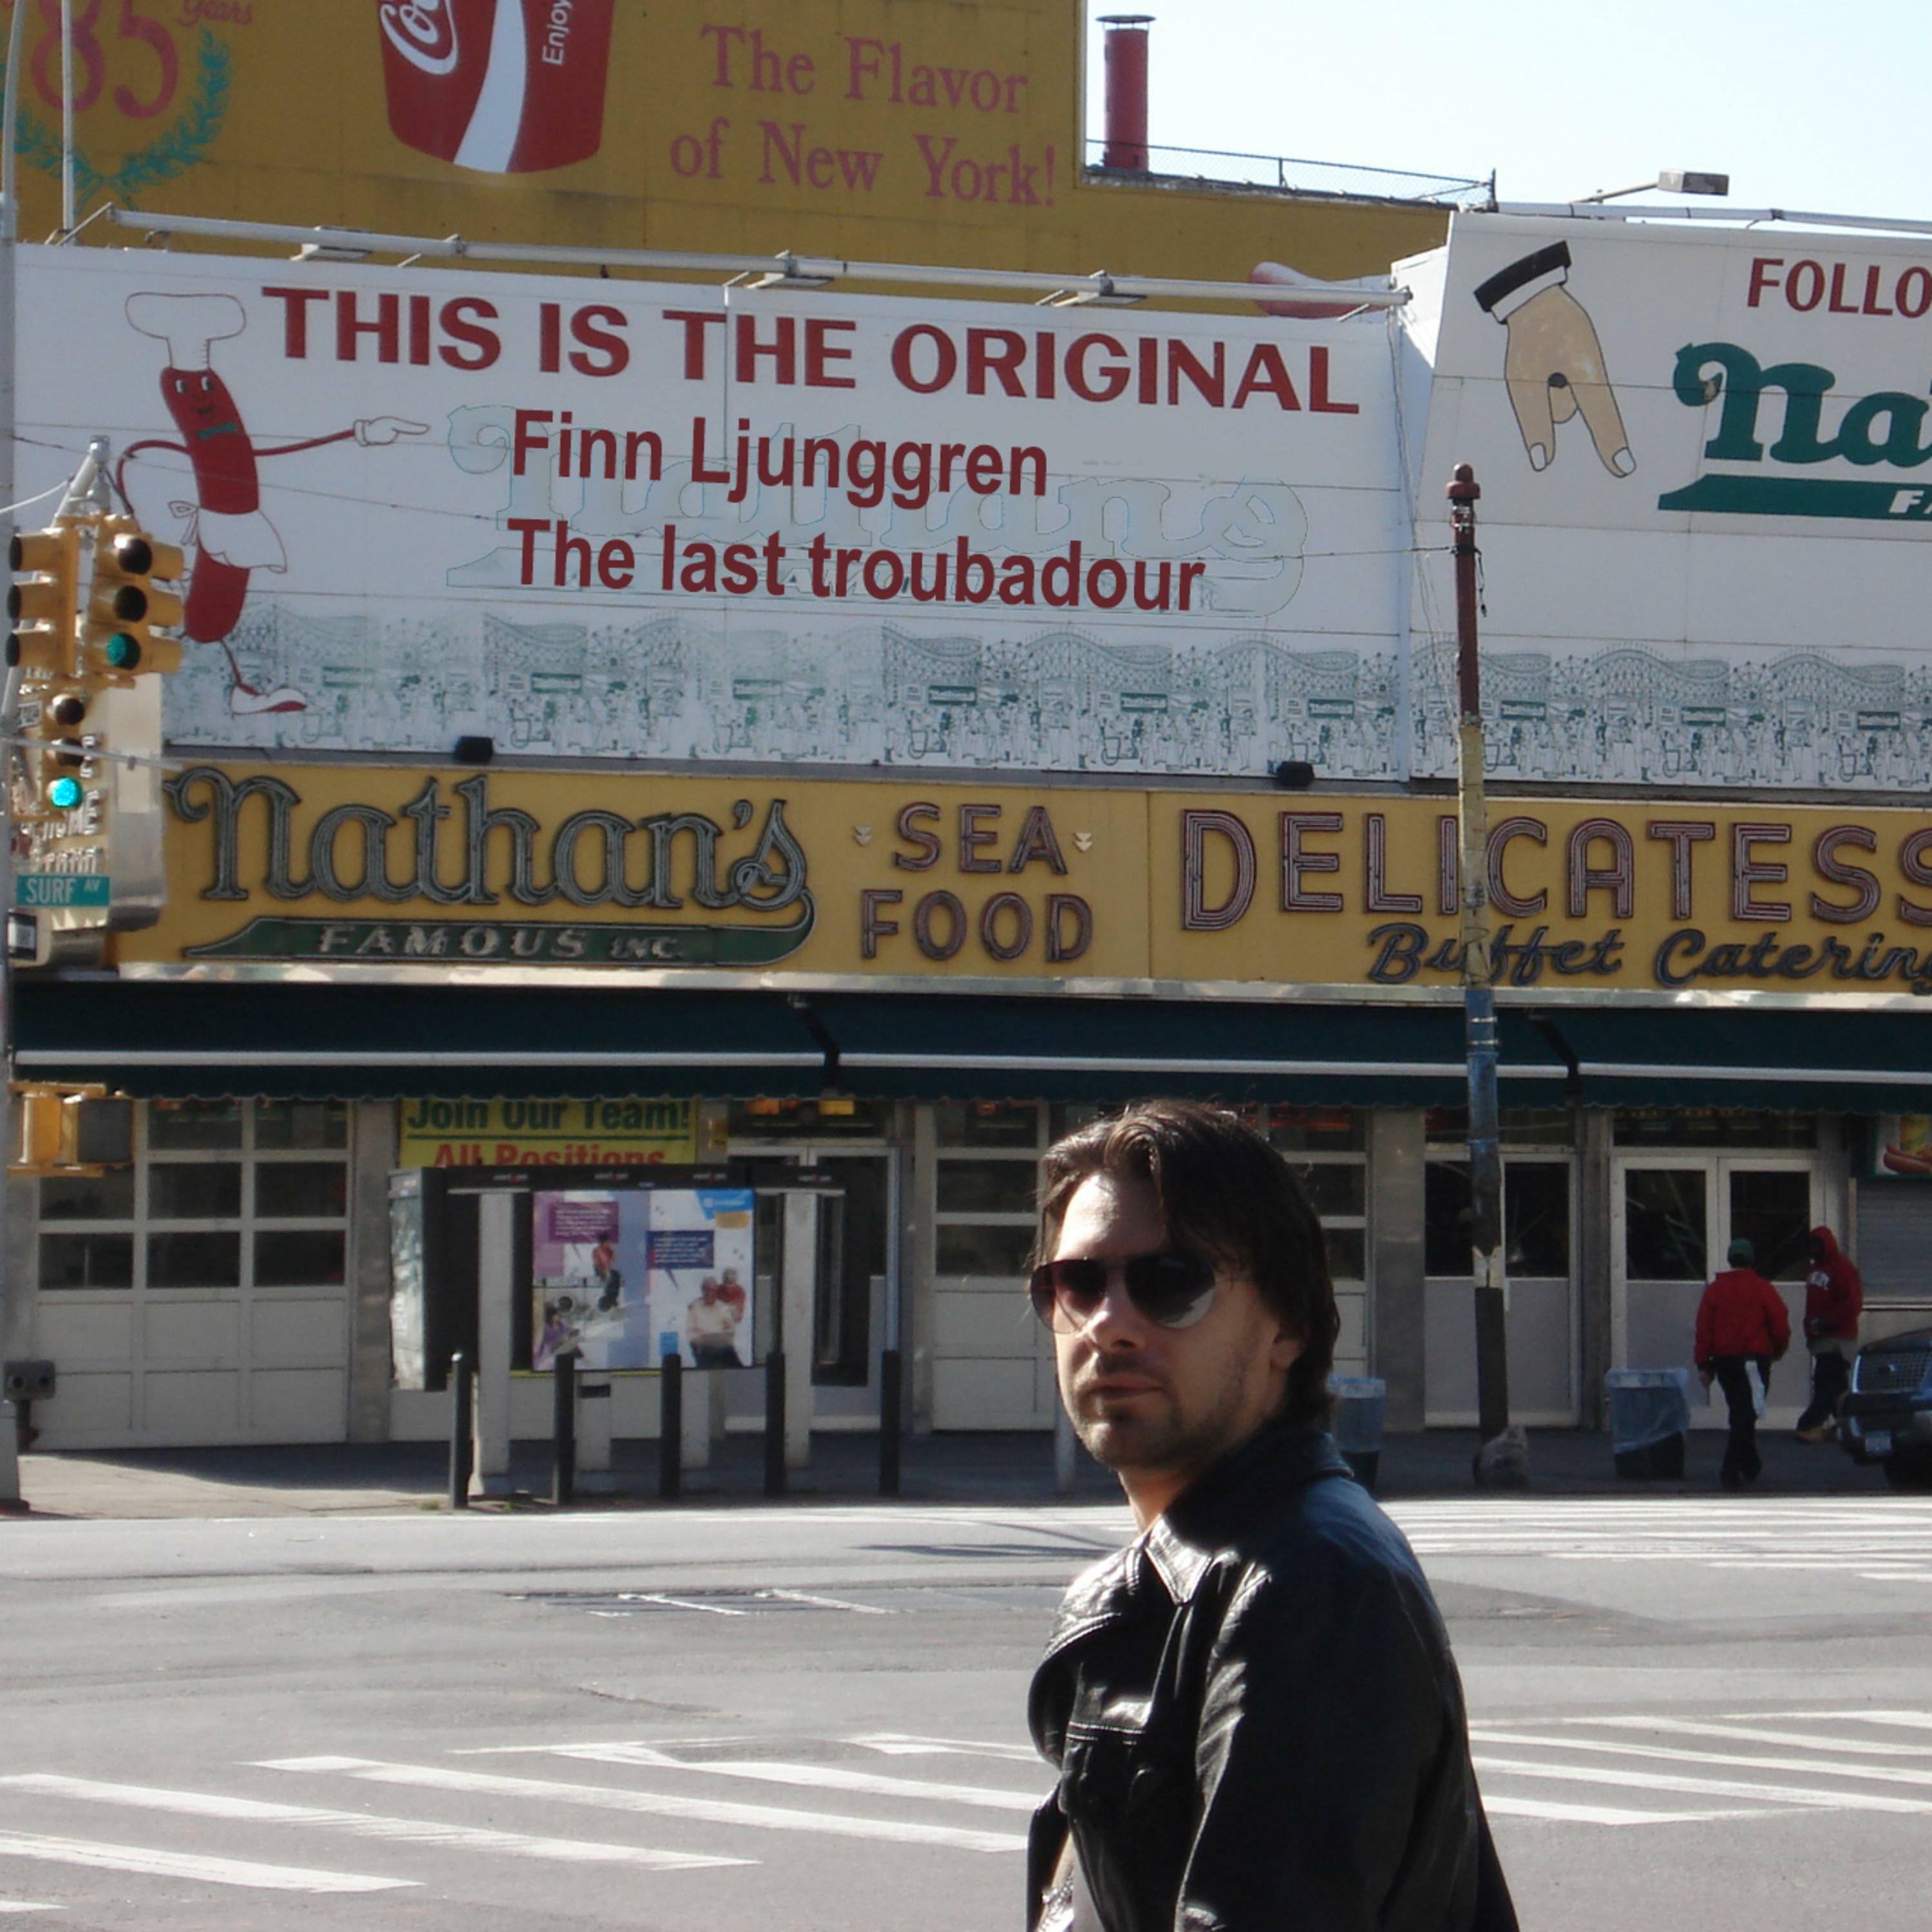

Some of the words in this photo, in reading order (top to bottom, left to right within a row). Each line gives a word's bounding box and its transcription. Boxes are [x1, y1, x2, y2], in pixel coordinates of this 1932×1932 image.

[31, 0, 178, 118] 85
[699, 23, 815, 97] The
[843, 35, 1030, 114] Flavor
[668, 116, 732, 180] of
[757, 120, 884, 192] New
[912, 133, 1057, 207] York!
[1747, 258, 1932, 318] FOLLO
[261, 285, 502, 371] THIS
[540, 302, 630, 377] IS
[663, 310, 857, 387] THE
[891, 323, 1360, 414] ORIGINAL
[513, 408, 663, 480] Finn
[690, 416, 1048, 510] Ljunggren
[507, 518, 636, 590] The
[661, 524, 786, 596] last
[807, 532, 1208, 612] troubadour
[163, 765, 808, 909] Nathan's
[892, 802, 1069, 876] SEA
[26, 877, 76, 904] SURF
[83, 878, 100, 892] AV
[860, 887, 1094, 964] FOOD
[317, 923, 587, 960] FAMOUS
[1367, 921, 1625, 987] Buffet
[407, 1100, 489, 1130] Join
